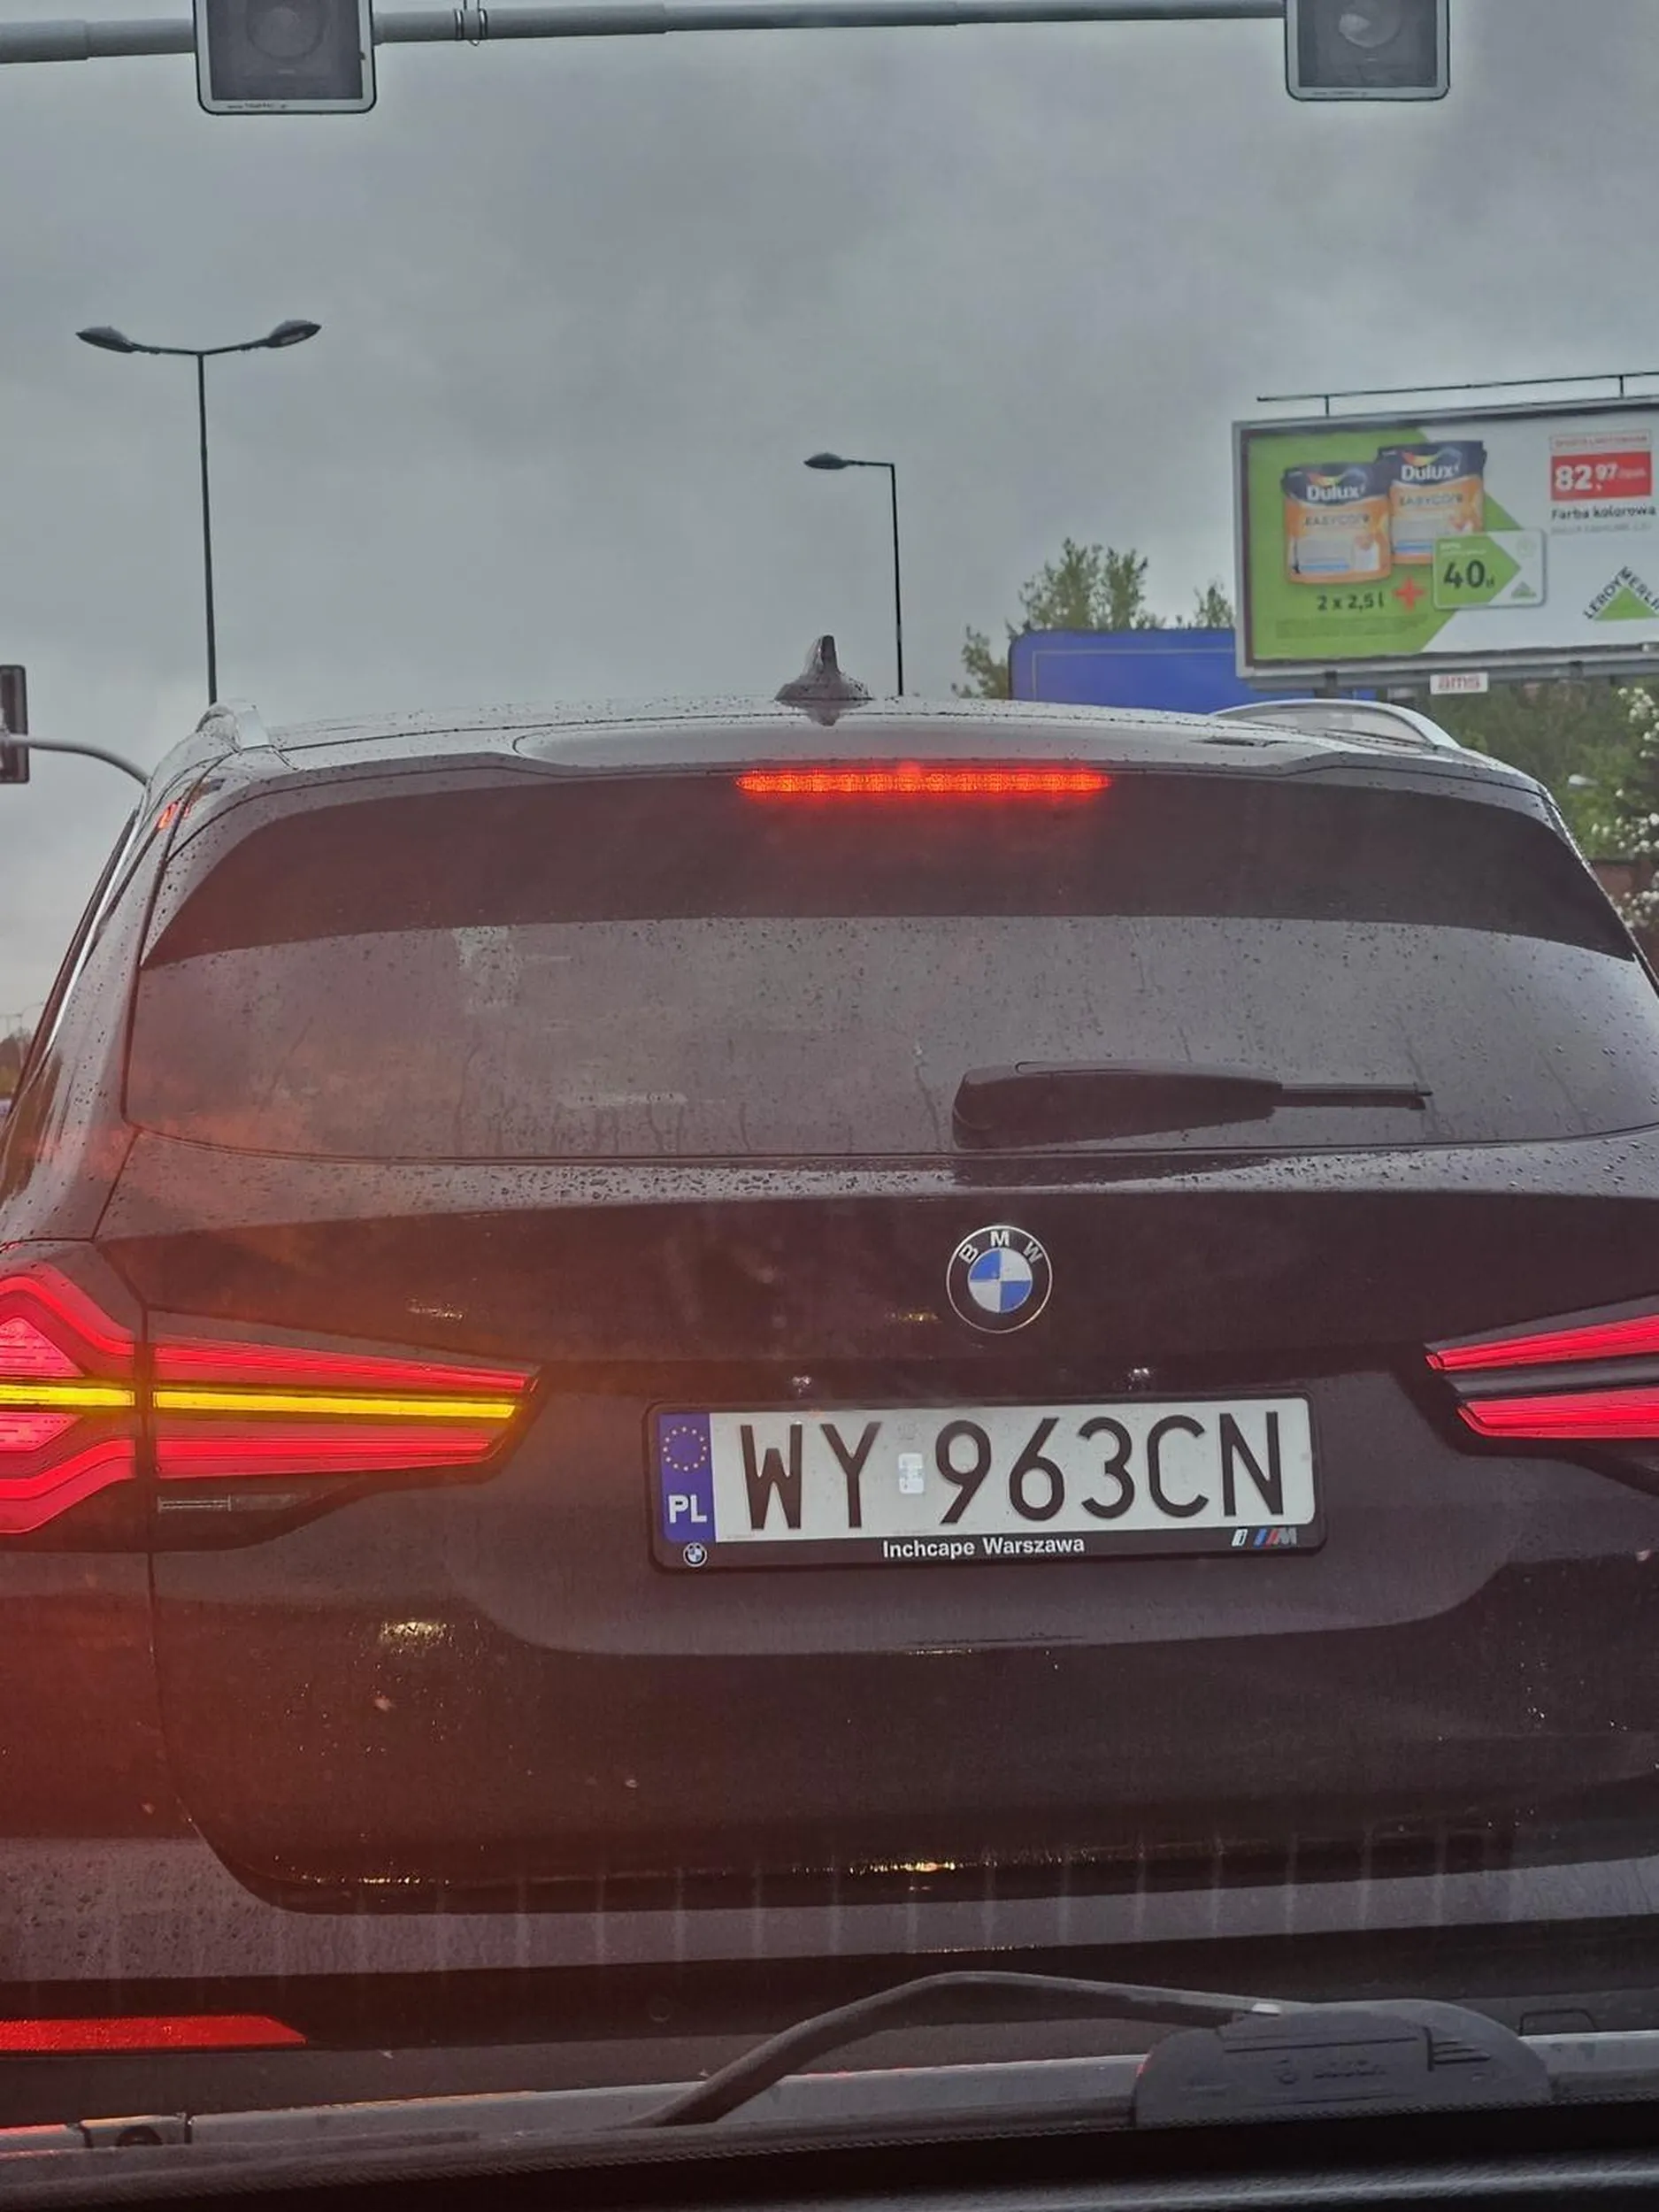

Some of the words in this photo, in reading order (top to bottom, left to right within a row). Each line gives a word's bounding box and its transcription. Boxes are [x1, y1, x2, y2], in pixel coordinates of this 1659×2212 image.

[1401, 465, 1451, 481] Dulux
[1306, 483, 1358, 502] Dulux
[1551, 509, 1590, 520] Farba
[1594, 504, 1656, 518] kolorowa
[1583, 573, 1623, 619] LEROY
[1617, 565, 1659, 611] MERLI
[1317, 595, 1327, 611] 2
[1438, 675, 1480, 690] ams
[958, 1230, 1043, 1264] BMW
[668, 1494, 707, 1524] PL
[740, 1421, 881, 1530] WY
[935, 1410, 1285, 1525] 963CN
[883, 1539, 975, 1560] Inchcape
[983, 1536, 1085, 1555] Warszawa
